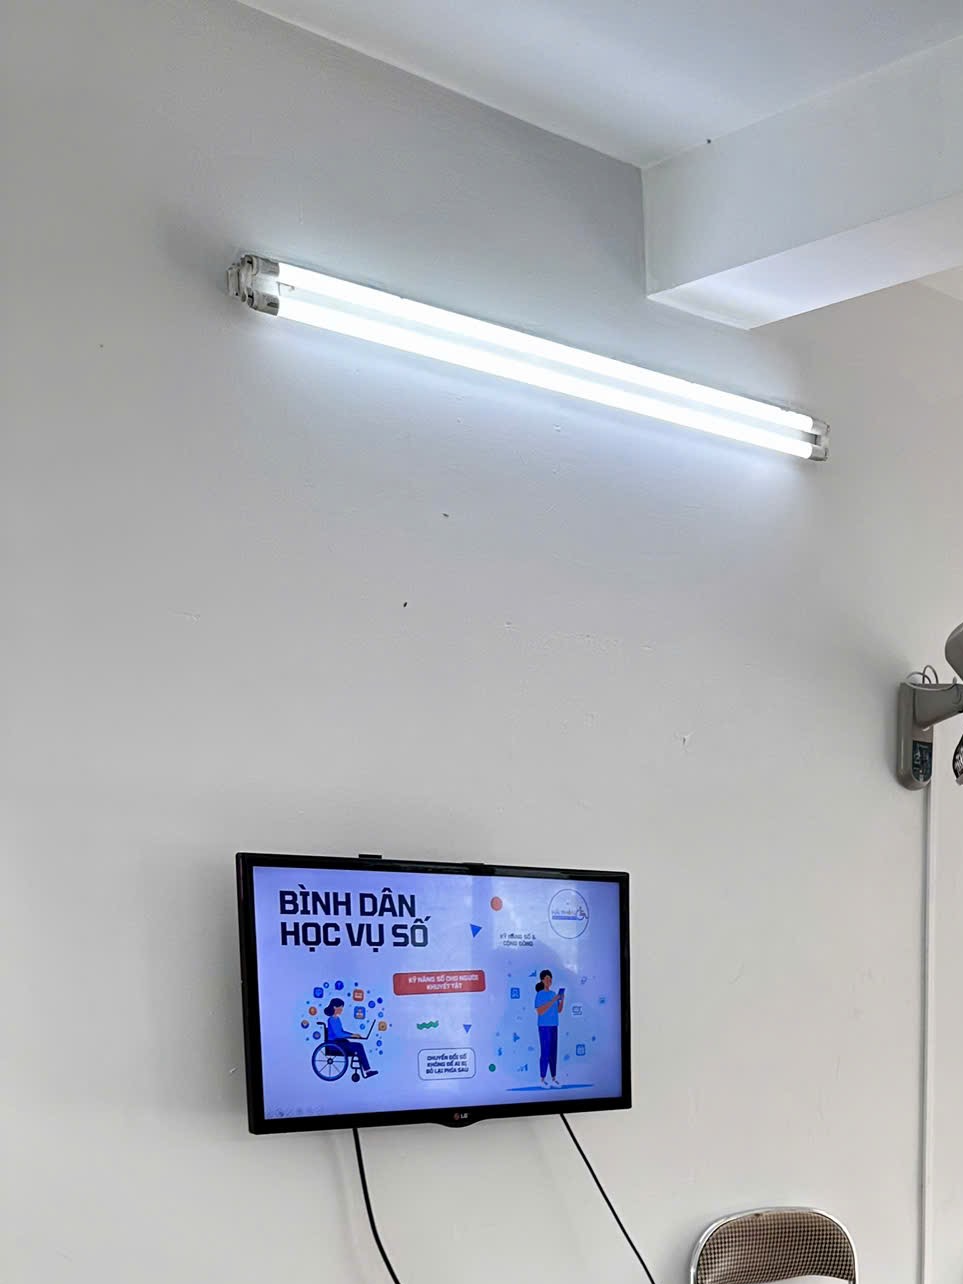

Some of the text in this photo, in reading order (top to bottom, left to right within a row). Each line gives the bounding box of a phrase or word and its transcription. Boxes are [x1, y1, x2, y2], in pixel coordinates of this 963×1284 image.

[279, 884, 416, 917] BÌNH DÂN
[281, 916, 431, 952] HỌC VỤ SỐ
